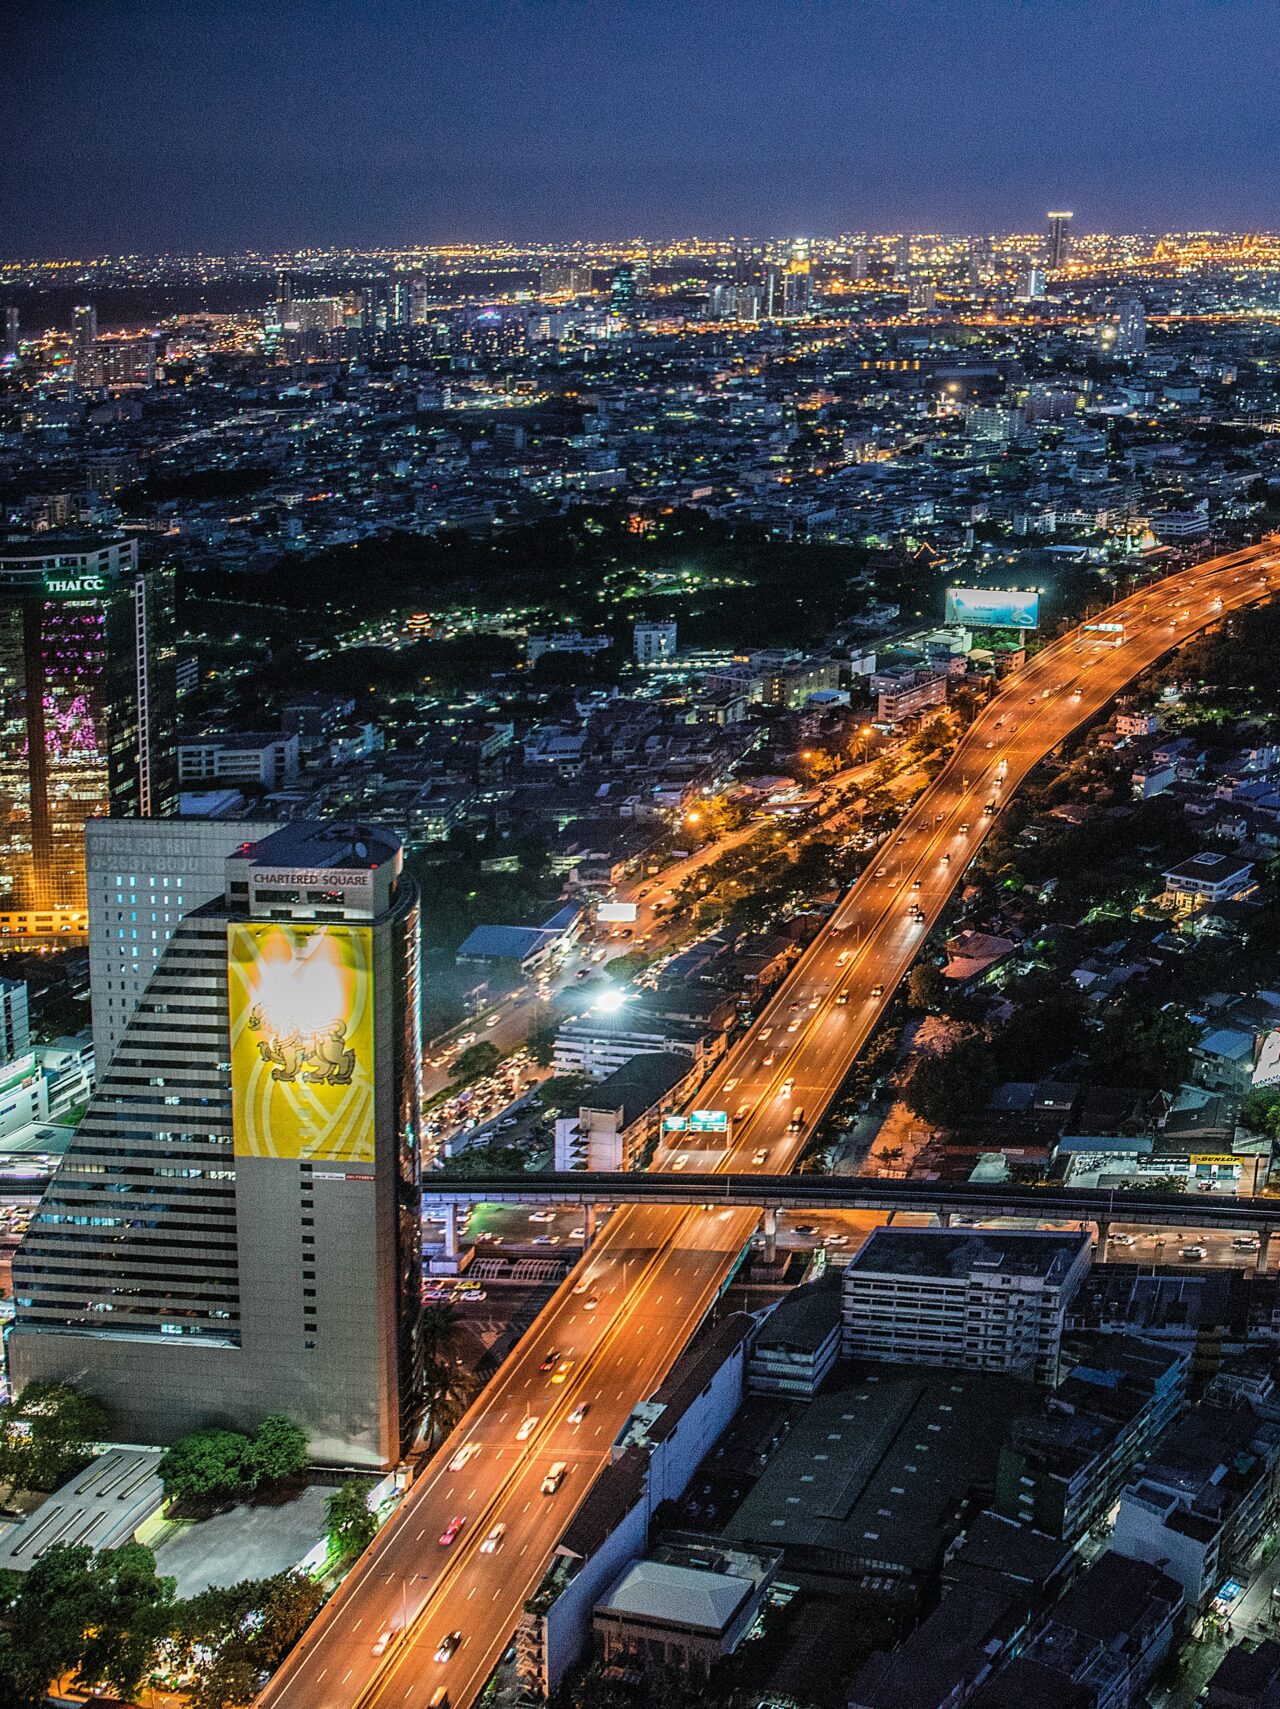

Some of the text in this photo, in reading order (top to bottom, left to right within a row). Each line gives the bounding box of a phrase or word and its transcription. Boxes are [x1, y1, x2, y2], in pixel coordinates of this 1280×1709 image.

[46, 579, 104, 592] THAI CC
[253, 873, 369, 886] CHARTERED SQUARE
